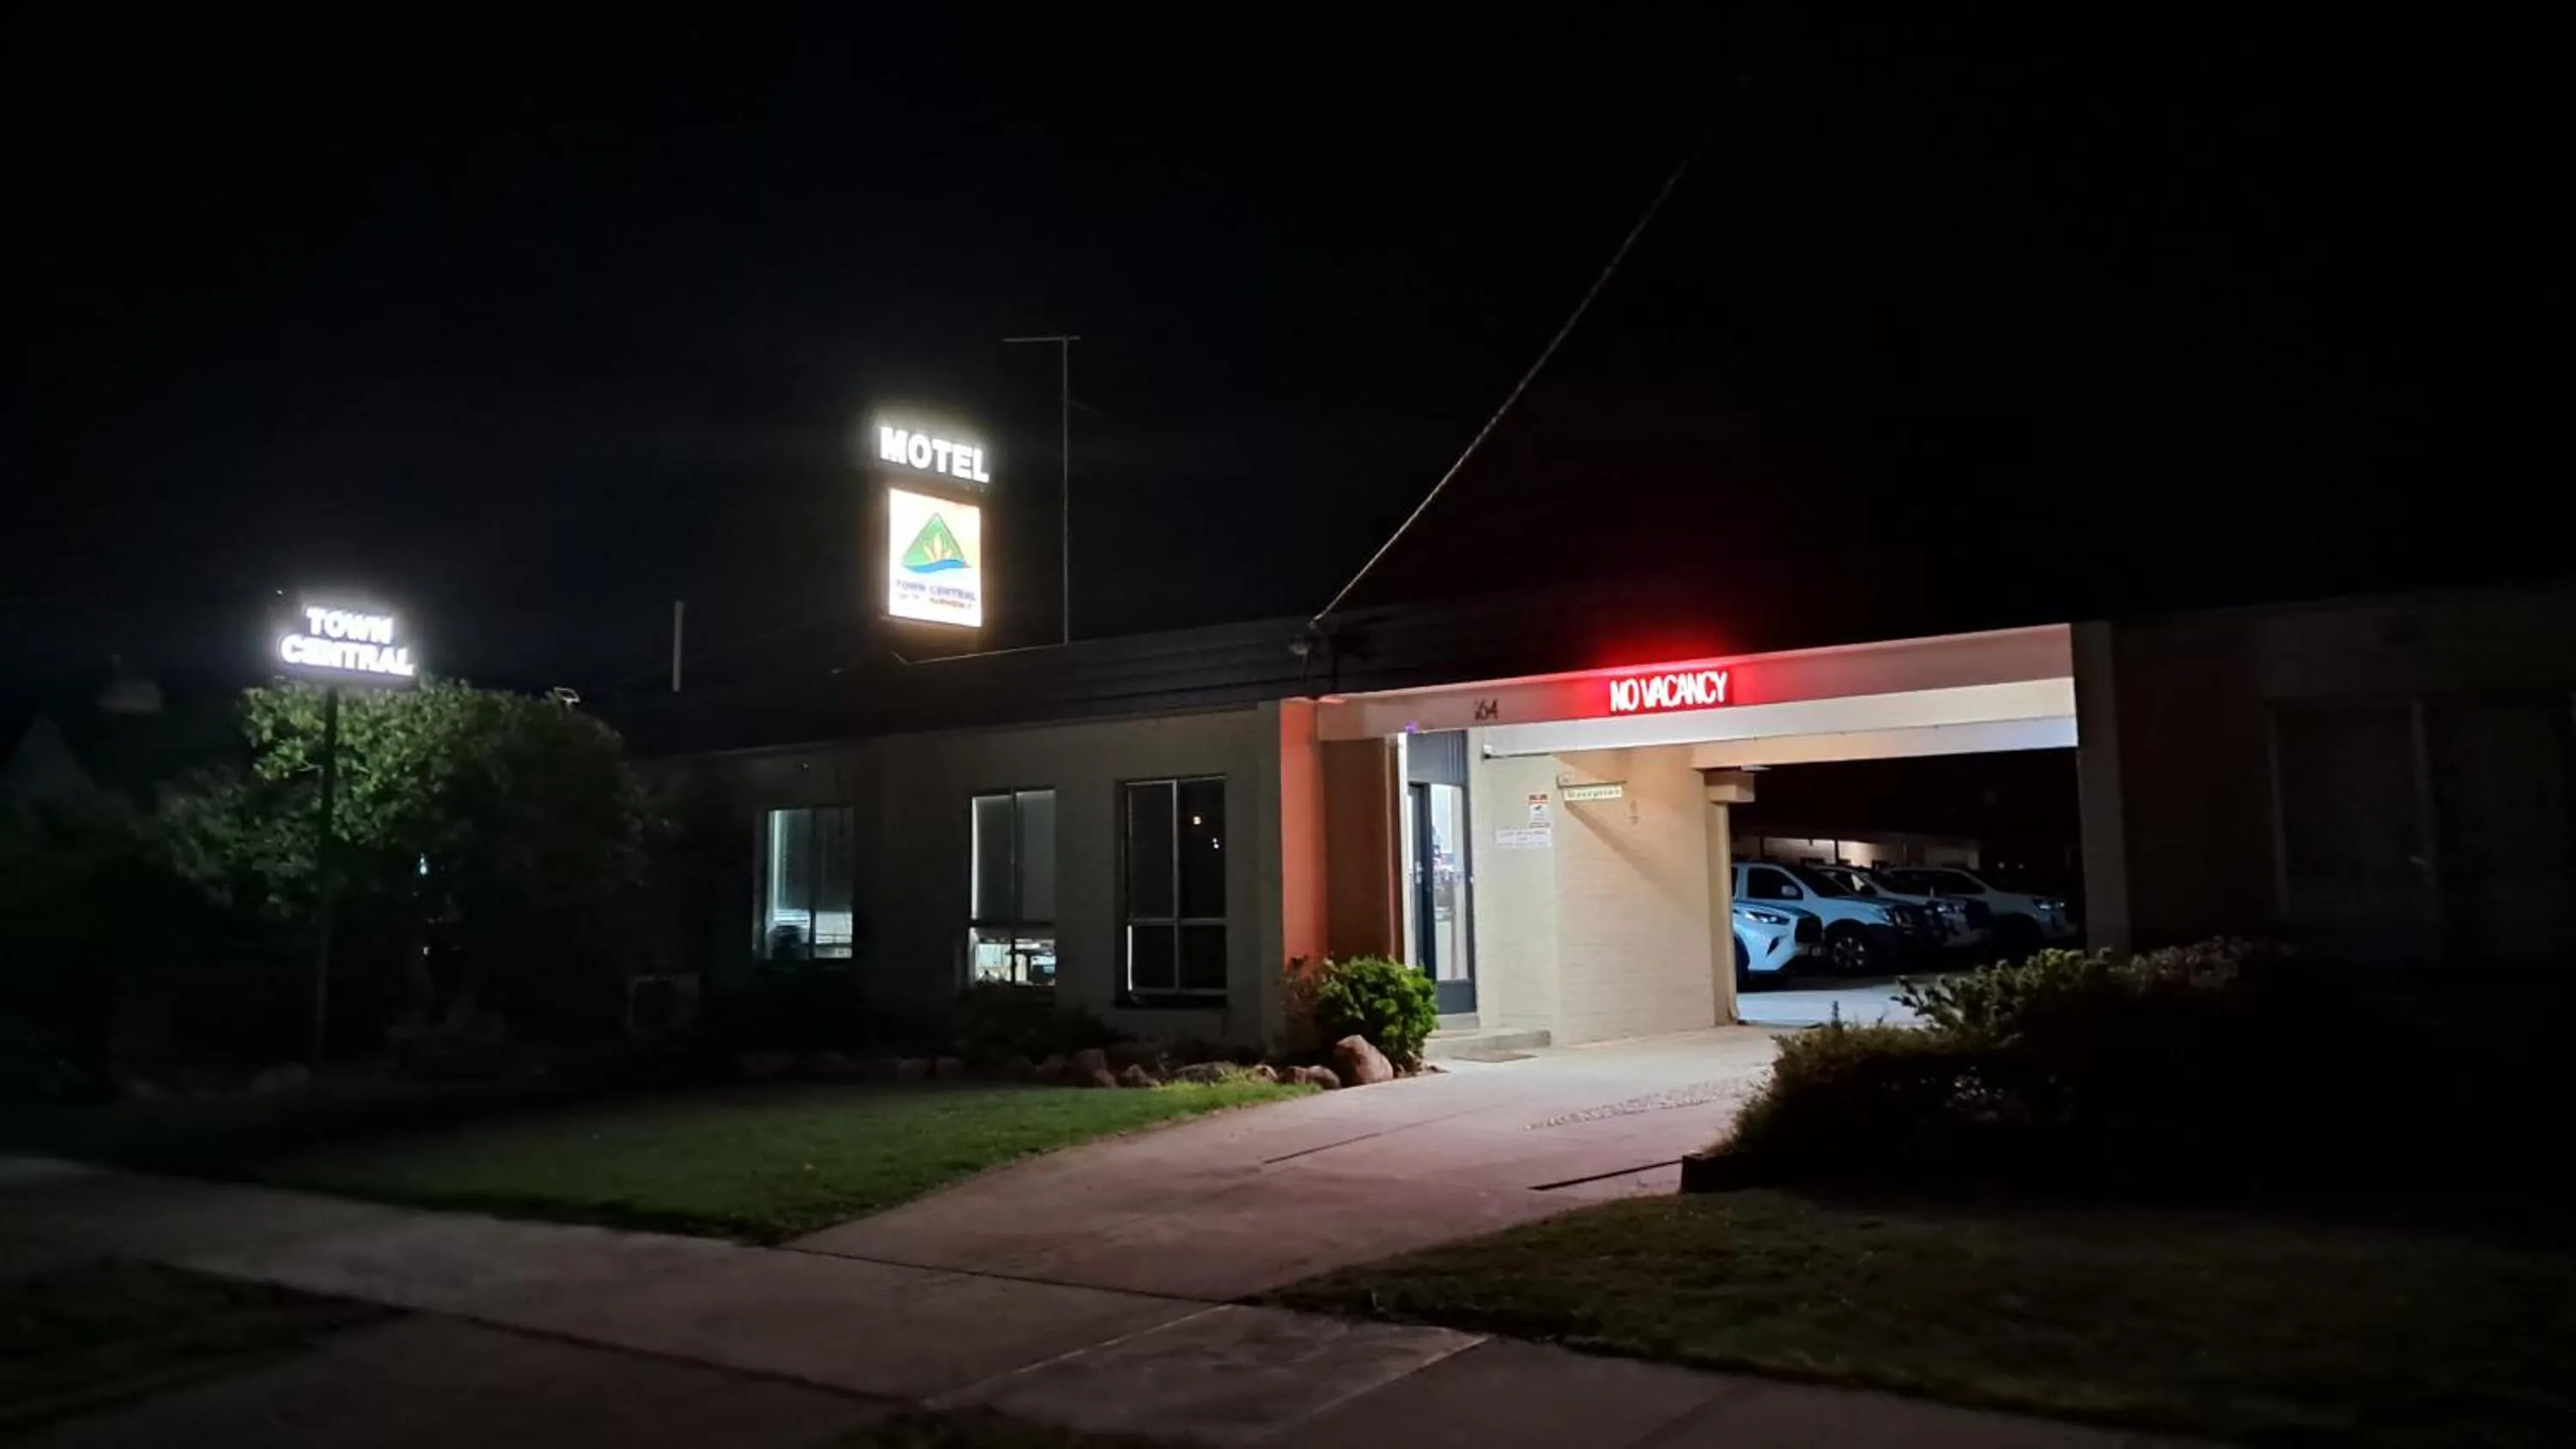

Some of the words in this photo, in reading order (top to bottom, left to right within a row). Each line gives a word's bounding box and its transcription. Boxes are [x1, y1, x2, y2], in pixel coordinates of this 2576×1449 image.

[880, 426, 990, 483] MOTEL
[307, 608, 393, 644] TOWN
[281, 634, 414, 676] CENTRAL
[1609, 677, 1641, 712] NO
[1639, 670, 1728, 709] VACANCY
